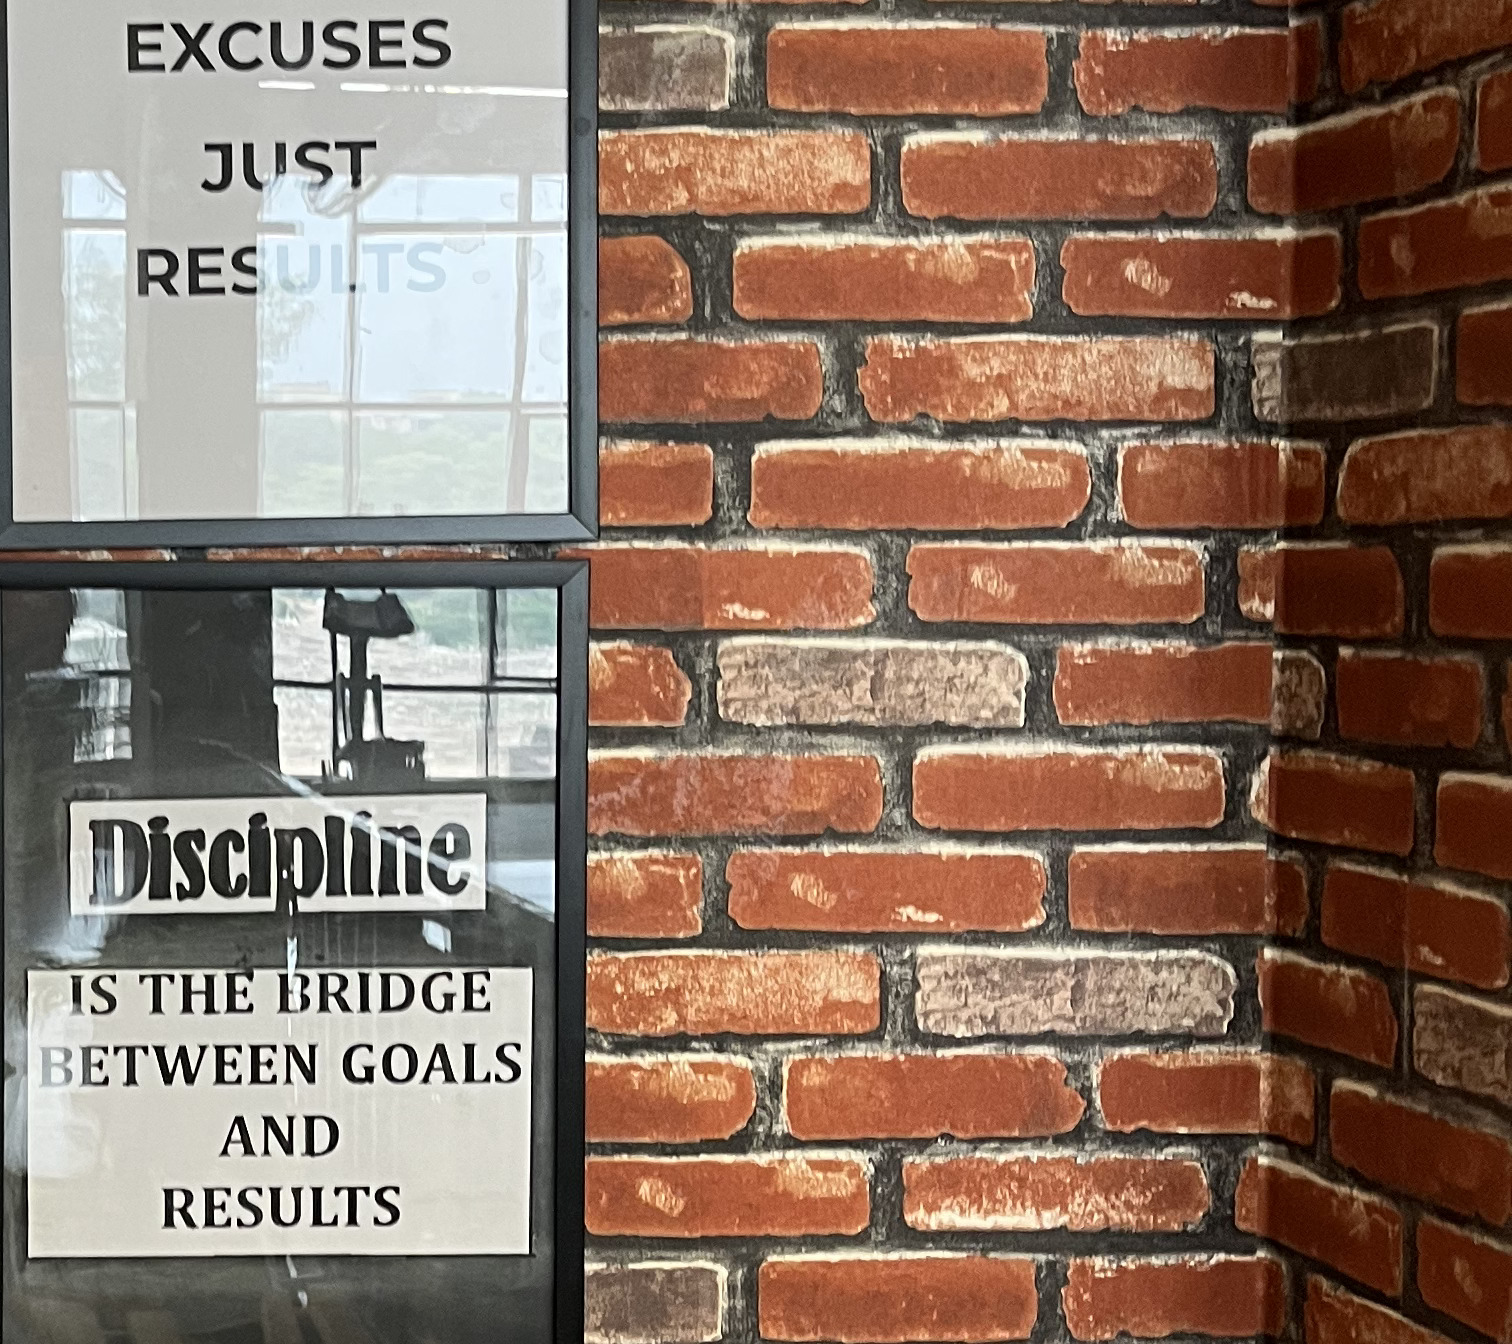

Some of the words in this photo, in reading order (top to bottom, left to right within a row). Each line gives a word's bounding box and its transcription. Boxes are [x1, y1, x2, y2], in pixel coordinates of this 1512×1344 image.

[125, 19, 453, 74] EXCUSES
[200, 140, 378, 193] JUST
[135, 241, 447, 298] RESULTS
[88, 810, 472, 911] Discipline
[70, 974, 118, 1016] IS
[138, 974, 254, 1016] THE
[276, 972, 492, 1016] BRIDGE
[40, 1044, 318, 1090] BETWEEN
[341, 1042, 524, 1086] GOALS
[219, 1114, 341, 1158] AND
[161, 1185, 402, 1231] RESULTS
